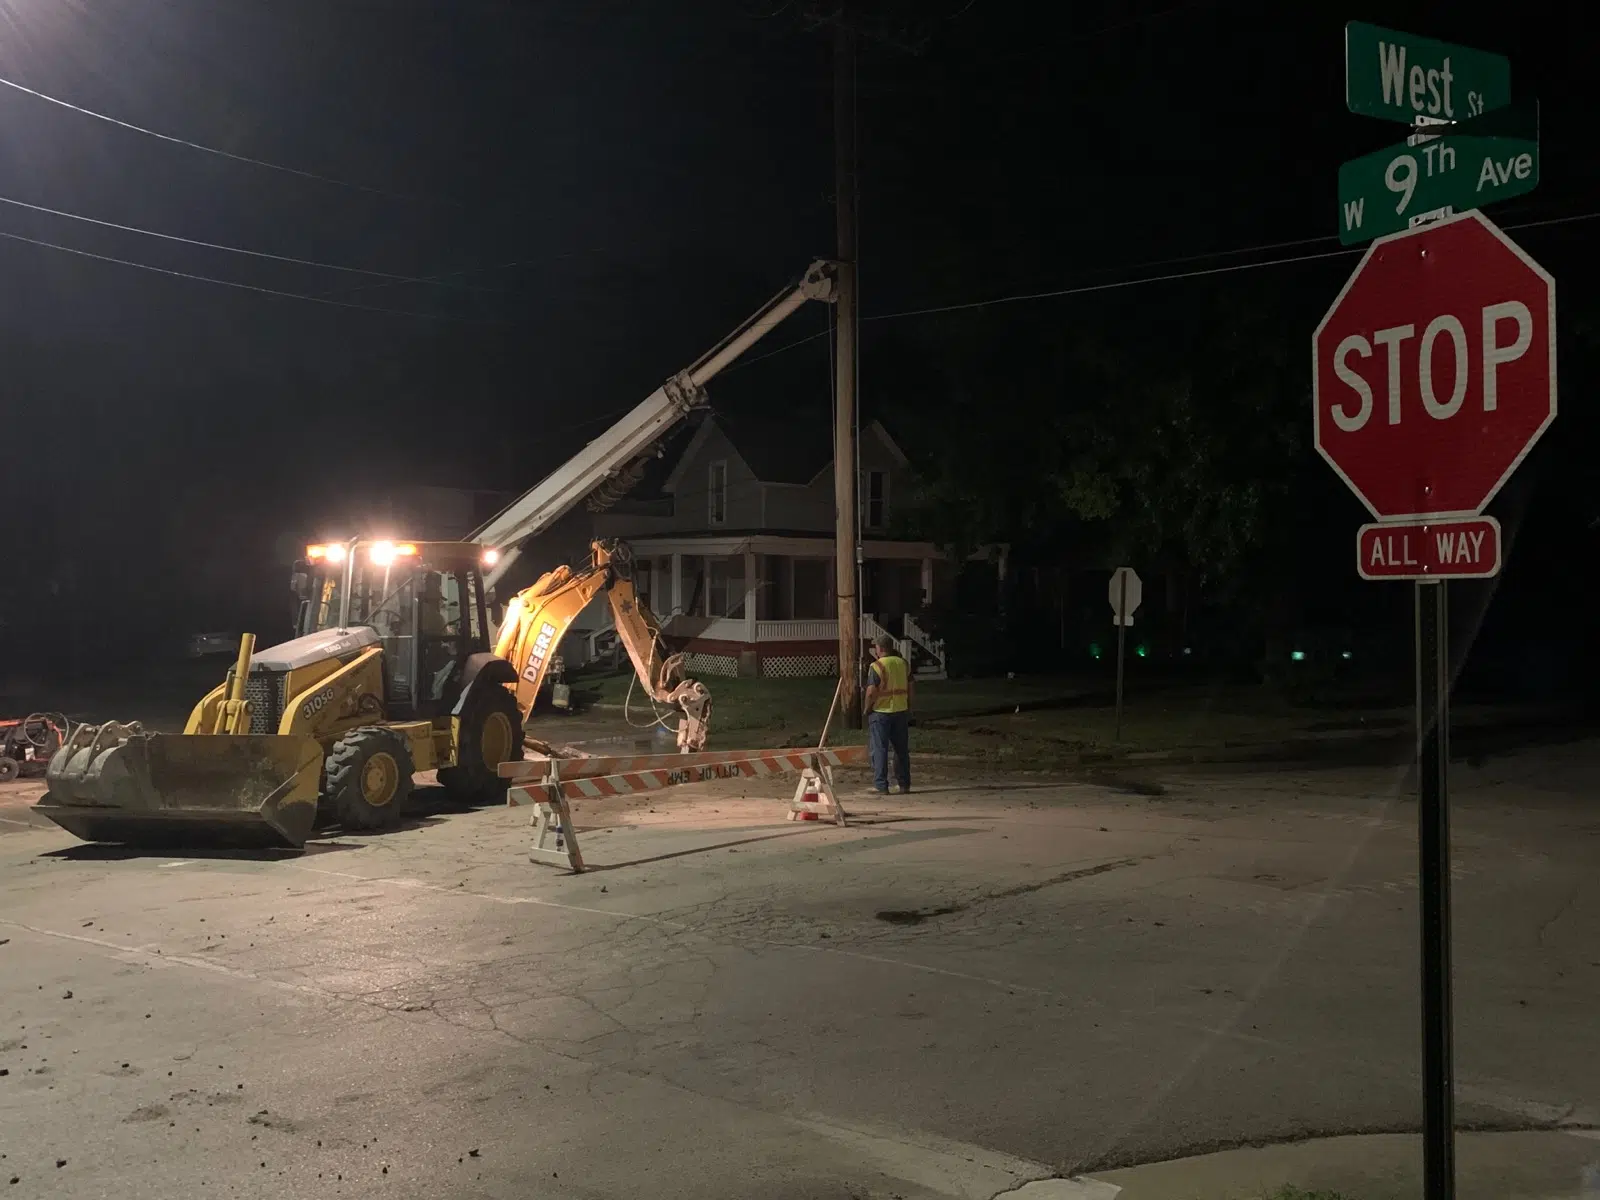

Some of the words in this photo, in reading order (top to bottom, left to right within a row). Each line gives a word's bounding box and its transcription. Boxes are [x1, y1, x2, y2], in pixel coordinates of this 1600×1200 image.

[1378, 40, 1454, 118] West
[1467, 90, 1484, 118] St
[1343, 197, 1364, 231] W
[1475, 152, 1533, 192] Ave
[1331, 300, 1533, 432] STOP
[1370, 535, 1418, 566] ALL
[1436, 530, 1485, 564] WAY
[521, 621, 557, 684] DEERE
[303, 688, 334, 719] 310SG
[698, 767, 712, 781] OF
[714, 764, 740, 779] CITY
